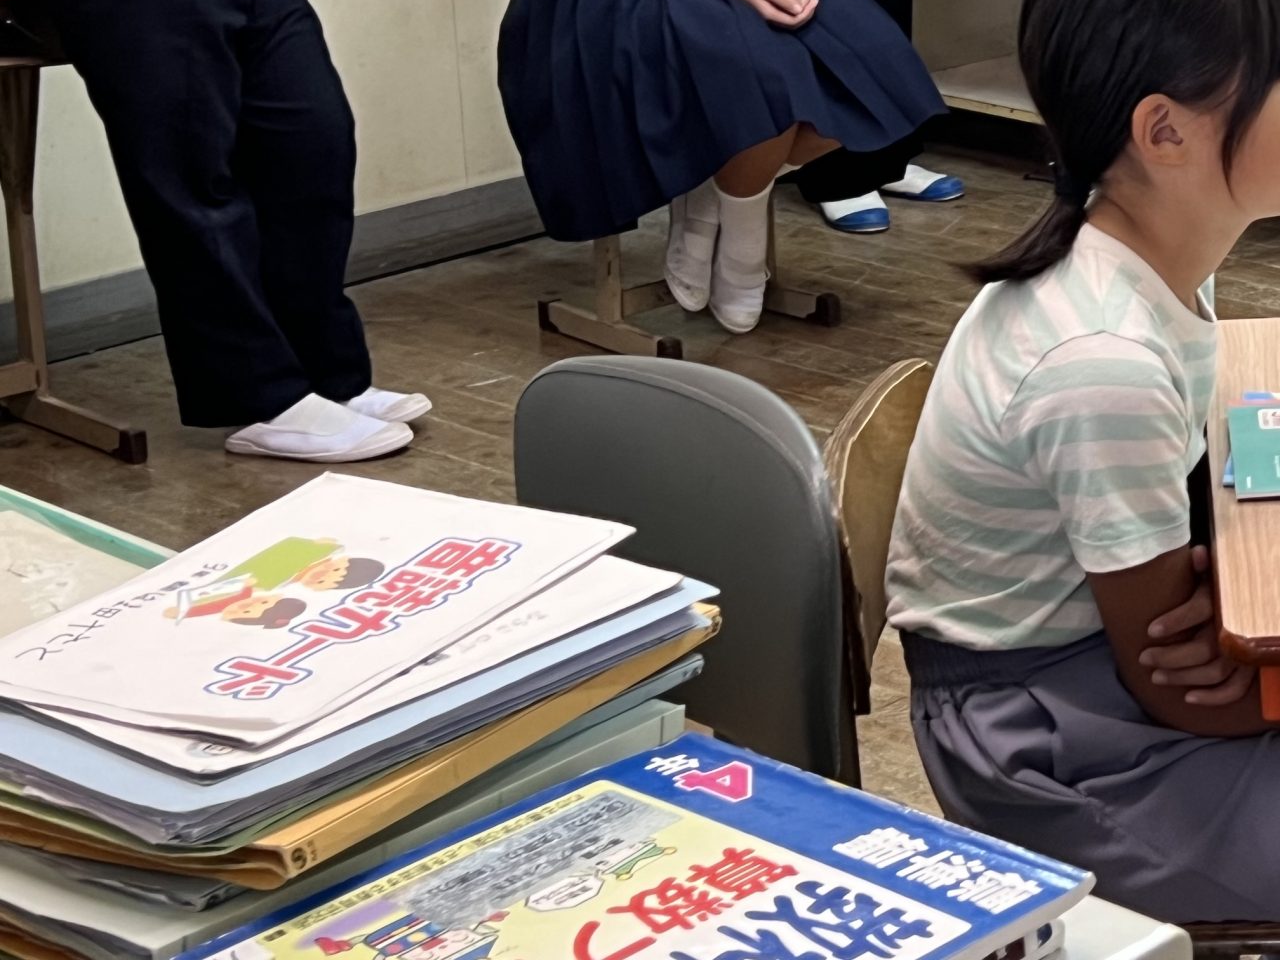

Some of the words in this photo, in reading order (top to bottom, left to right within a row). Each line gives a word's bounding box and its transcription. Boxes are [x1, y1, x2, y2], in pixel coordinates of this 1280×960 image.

[207, 538, 520, 699] 音読カード
[645, 753, 754, 803] 4年
[830, 826, 1044, 916] 標準編
